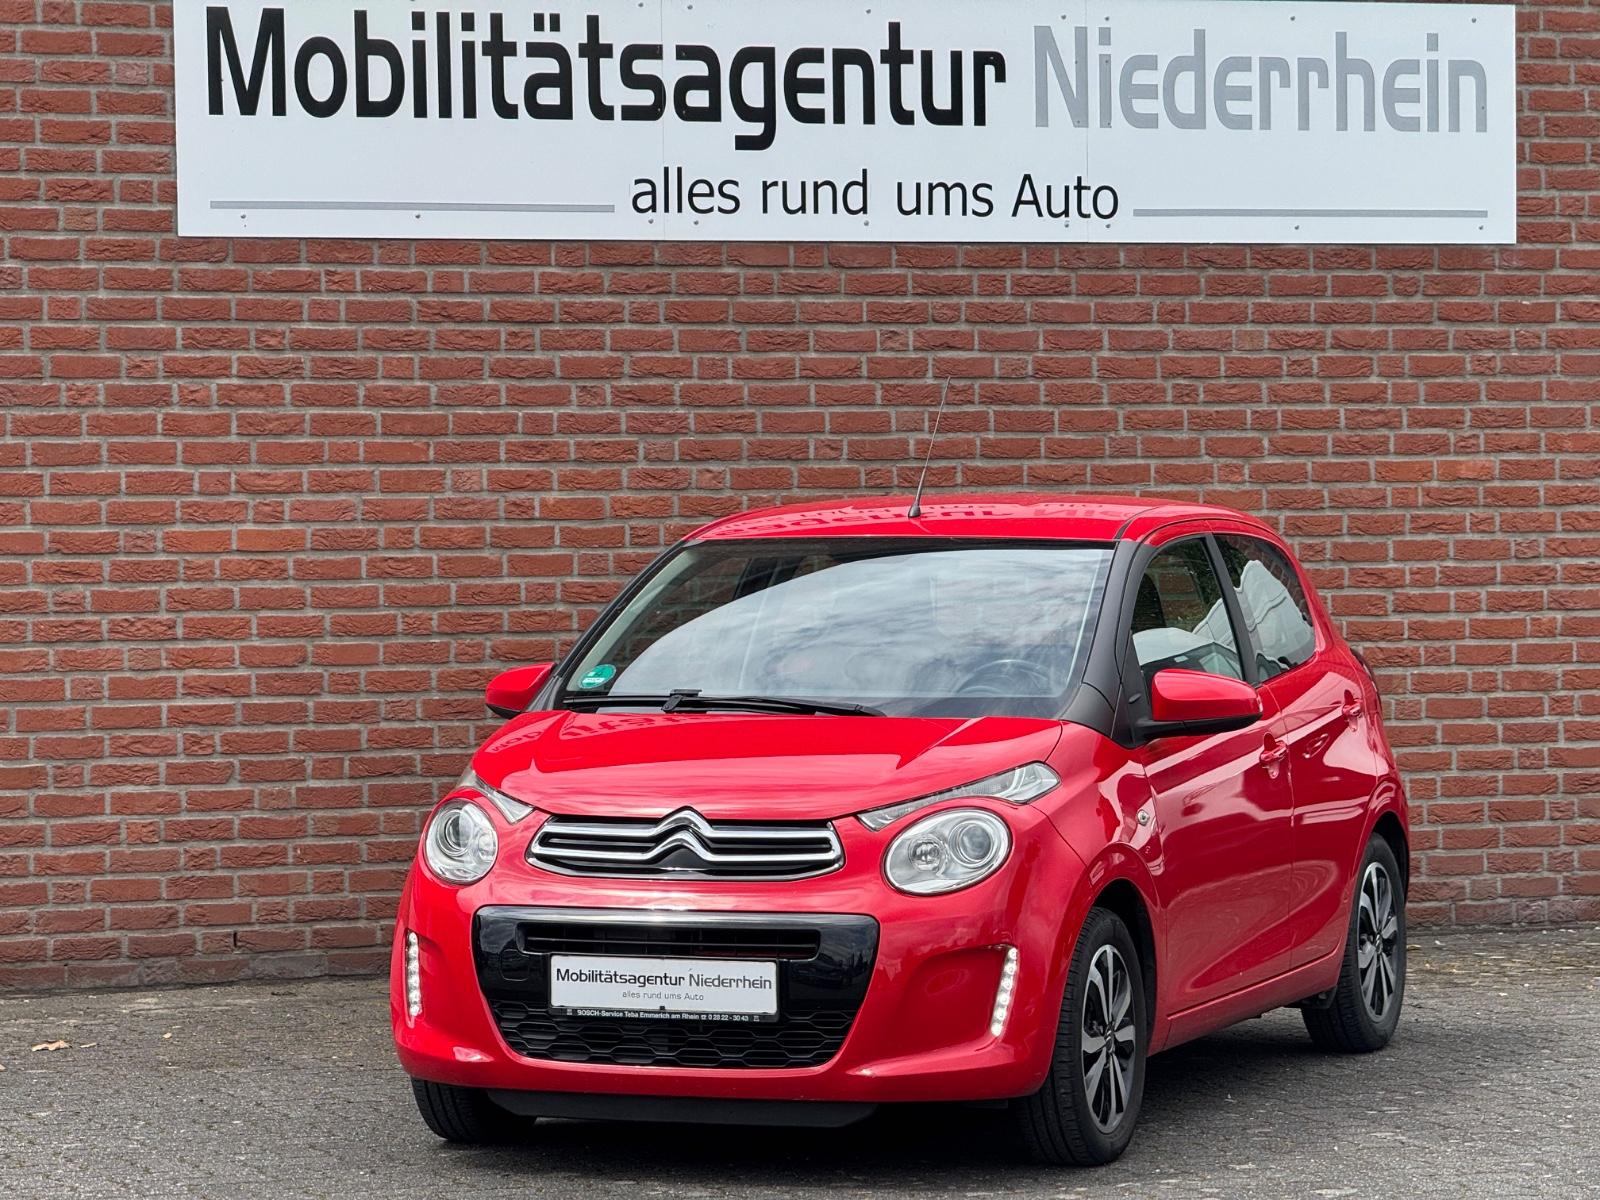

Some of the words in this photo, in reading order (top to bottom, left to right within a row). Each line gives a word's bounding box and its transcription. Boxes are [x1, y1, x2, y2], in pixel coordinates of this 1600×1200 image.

[206, 6, 1007, 152] Mobilitätsagentur
[1033, 25, 1488, 133] Niederrhein
[631, 165, 741, 215] alles
[761, 167, 869, 216] rund
[896, 181, 994, 218] ums
[1010, 173, 1119, 220] Auto
[556, 968, 686, 988] Mobilitätsagentur
[688, 973, 772, 990] Niederrhein
[622, 990, 641, 999] alles
[643, 991, 662, 1000] rund
[683, 992, 705, 1001] Auto
[640, 1011, 670, 1019] Emmerich
